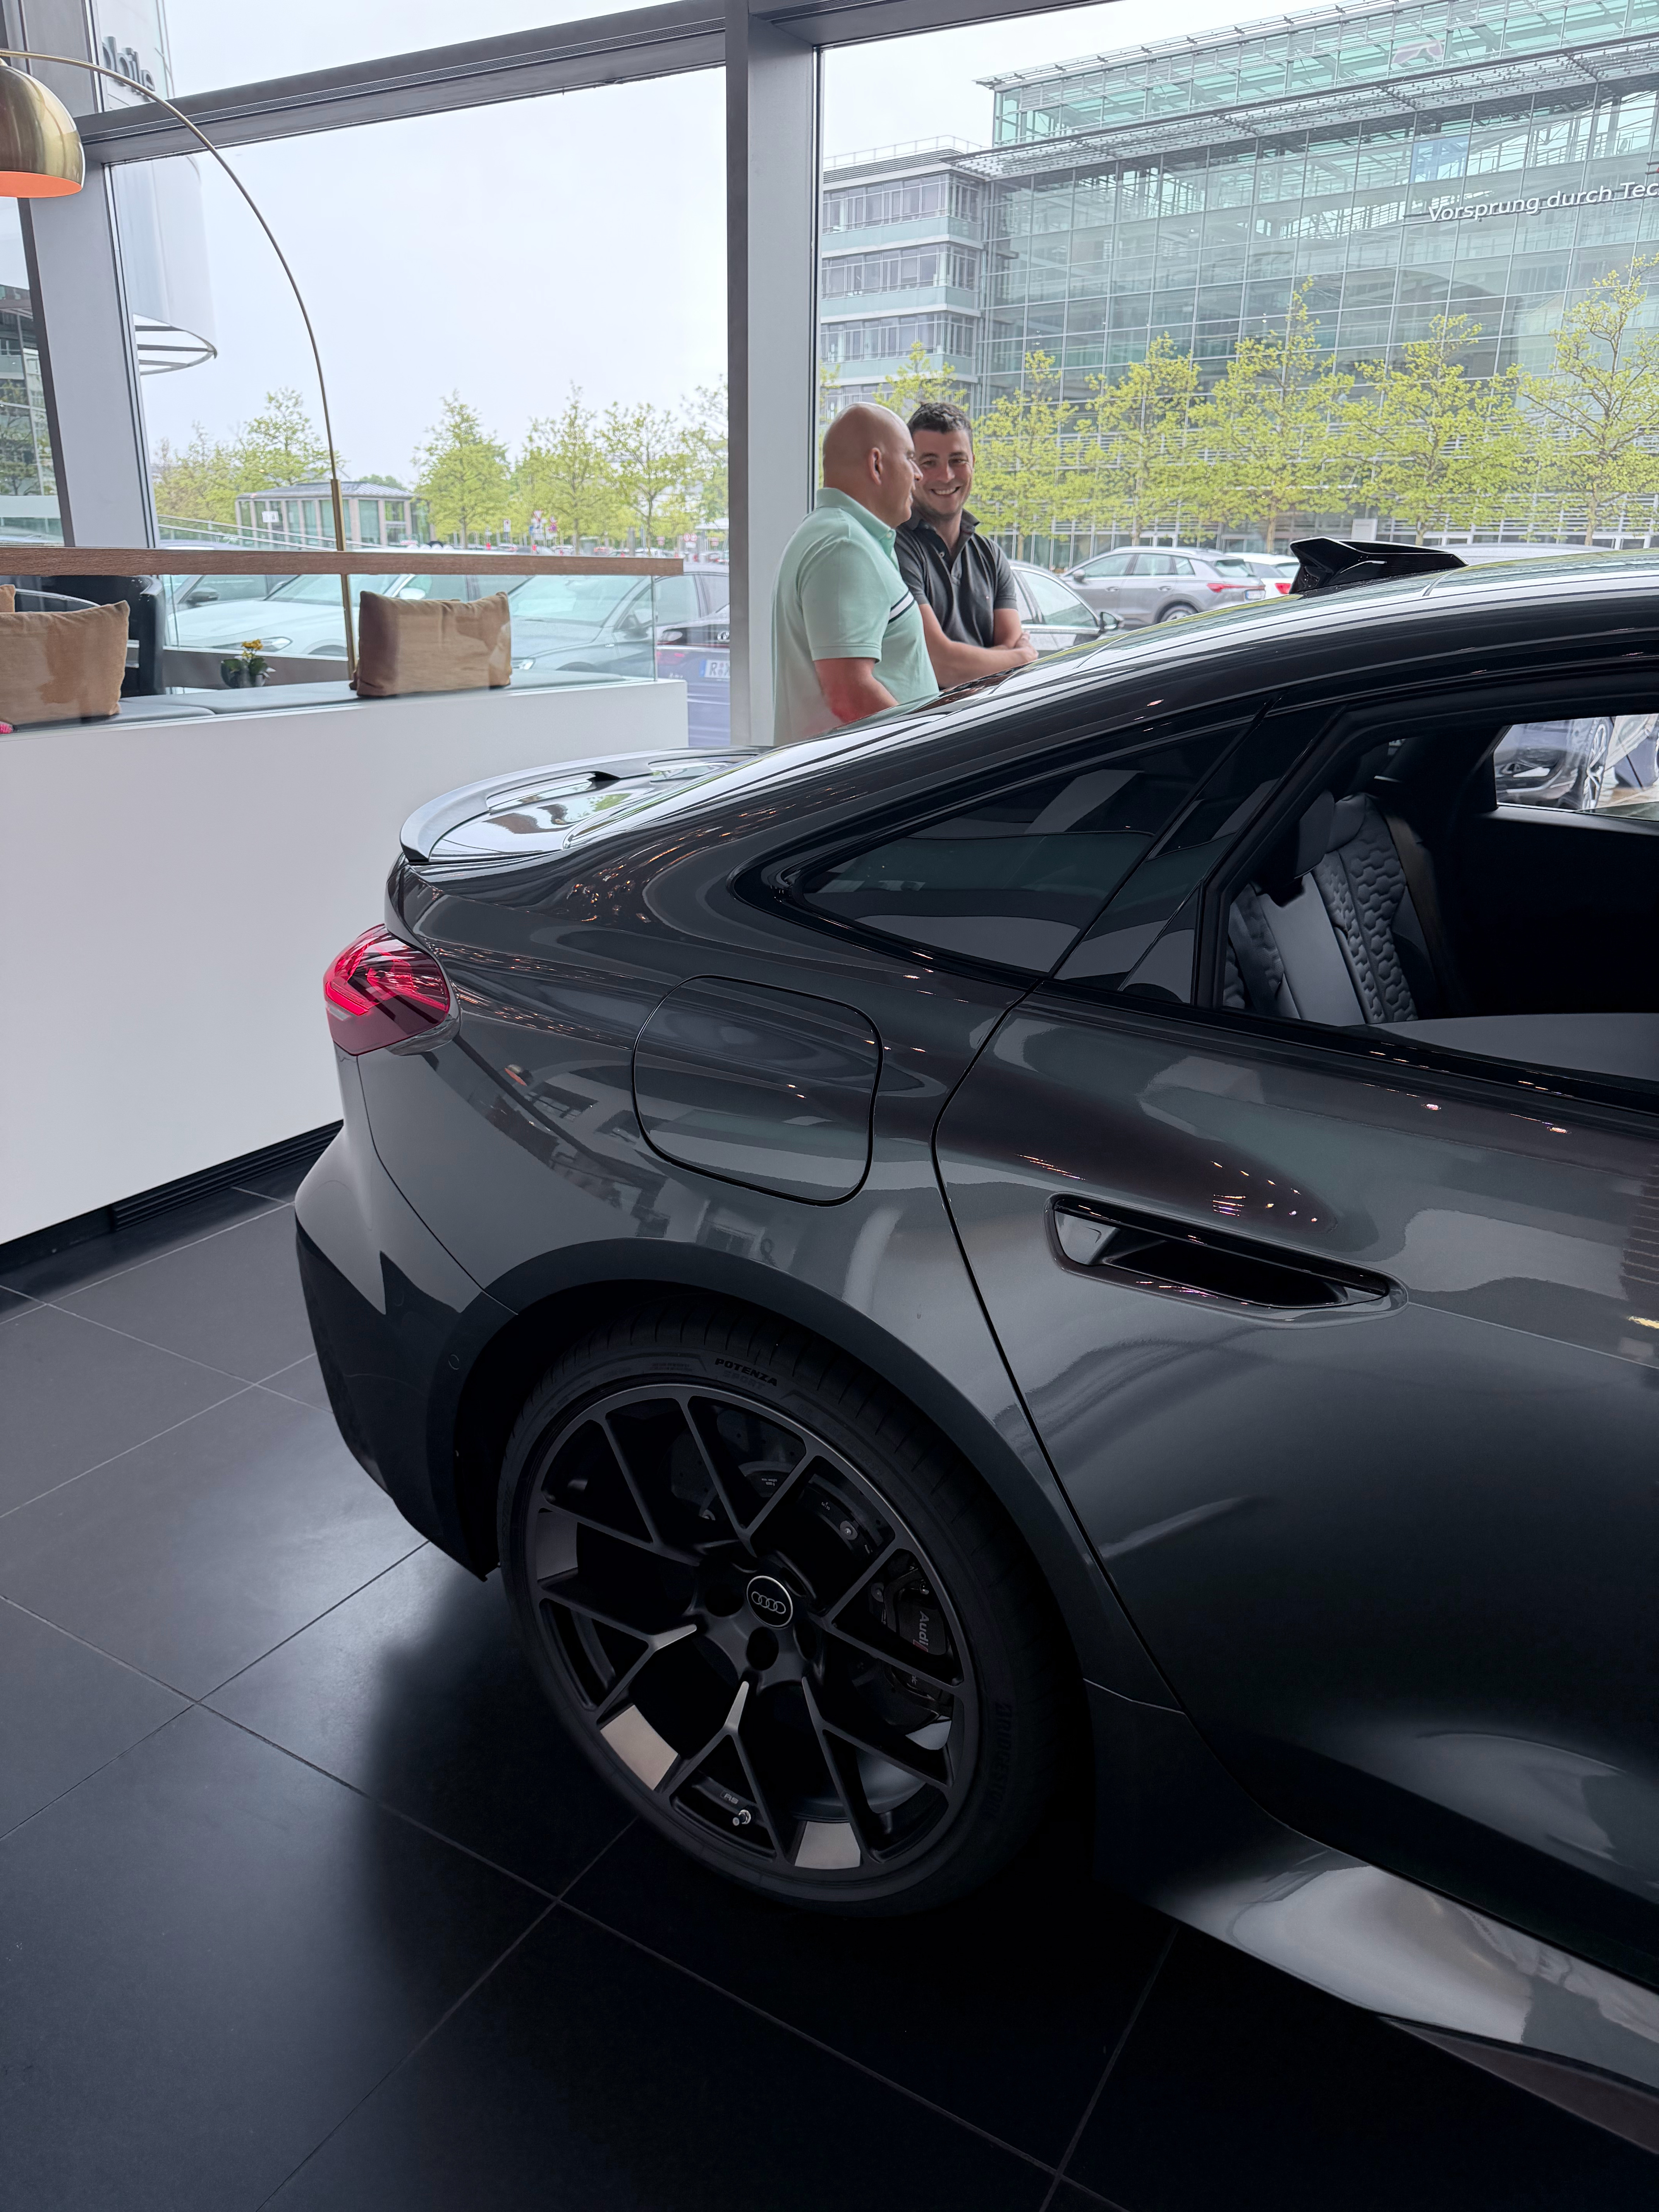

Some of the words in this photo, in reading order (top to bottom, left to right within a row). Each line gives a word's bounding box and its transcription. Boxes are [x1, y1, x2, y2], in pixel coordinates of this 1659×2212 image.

[1429, 197, 1539, 222] Vorsprung
[1547, 185, 1612, 208] durch
[1620, 182, 1659, 199] Tec
[715, 1358, 777, 1386] POTENZA
[919, 1611, 929, 1645] Audi
